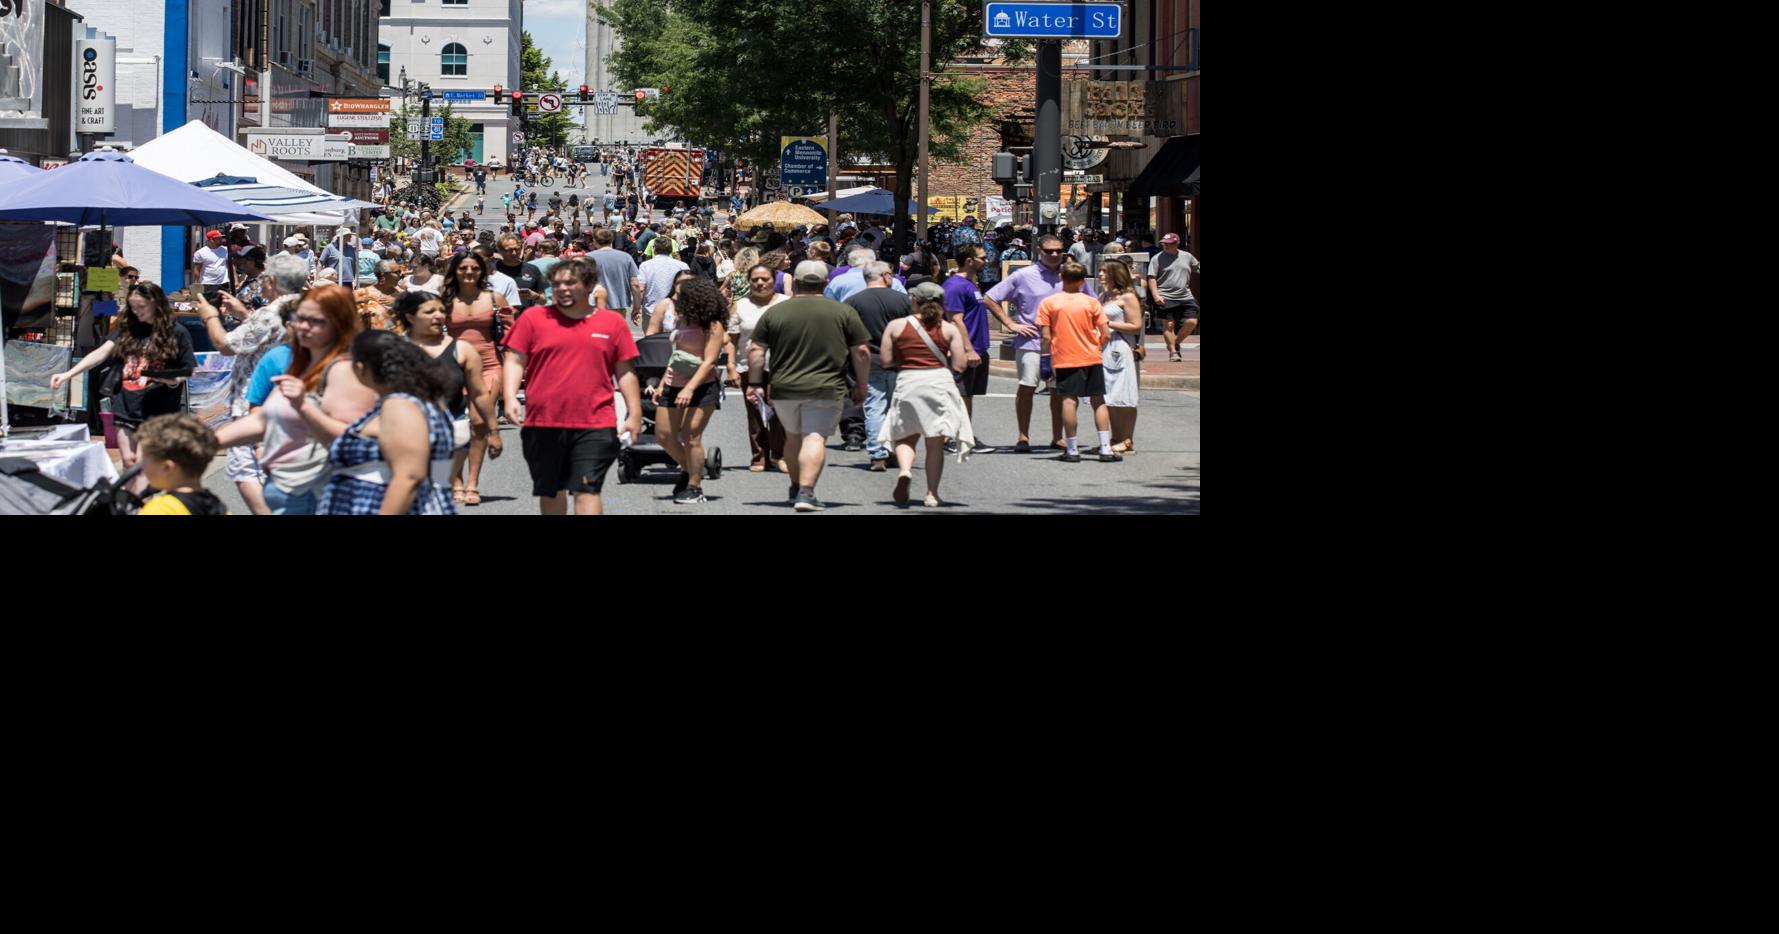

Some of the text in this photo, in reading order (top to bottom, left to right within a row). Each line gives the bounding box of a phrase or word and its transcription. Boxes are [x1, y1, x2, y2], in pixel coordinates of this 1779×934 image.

[1015, 10, 1117, 29] Water St
[83, 47, 104, 100] oasis
[81, 107, 105, 115] FINE ART
[81, 117, 105, 125] & CRAFT
[268, 138, 313, 147] VALLEY
[272, 146, 311, 155] ROOTS
[793, 187, 801, 196] P
